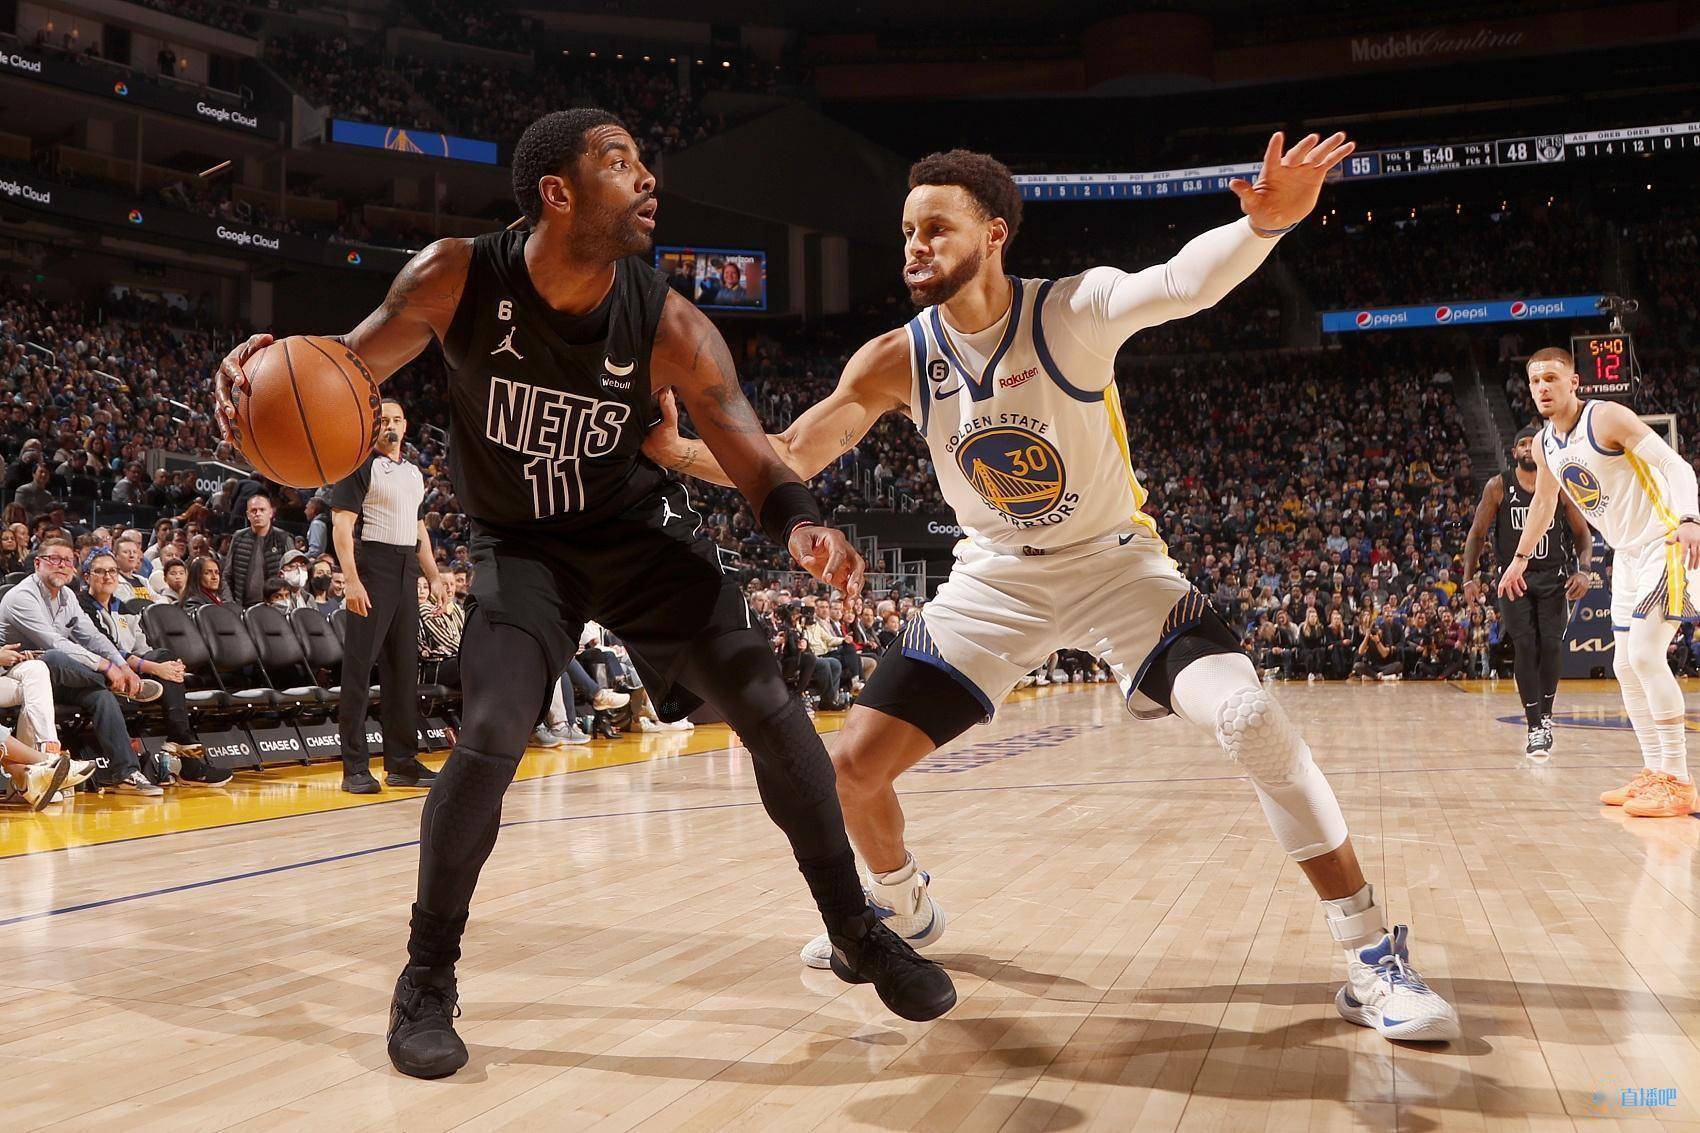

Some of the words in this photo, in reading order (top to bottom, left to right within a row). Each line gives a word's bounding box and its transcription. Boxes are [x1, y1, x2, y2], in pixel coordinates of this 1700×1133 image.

[1351, 36, 1424, 62] Modelo
[10, 54, 41, 72] Cloud
[196, 101, 229, 121] Google
[231, 112, 257, 127] Cloud
[1465, 146, 1480, 154] TOL
[1507, 143, 1527, 161] 48
[1575, 145, 1586, 157] 13
[1606, 142, 1613, 154] 4
[1633, 140, 1645, 152] 12
[1664, 137, 1671, 150] 0
[1693, 135, 1700, 147] 0
[1386, 152, 1401, 161] TOL
[1423, 147, 1453, 164] 5:40
[1465, 158, 1480, 166] FLS
[1484, 155, 1491, 165] 4
[1352, 156, 1370, 175] 55
[1387, 164, 1401, 172] FLS
[22, 185, 50, 203] Cloud
[1084, 185, 1091, 196] 2
[1132, 184, 1142, 195] 12
[1156, 183, 1168, 194] 26
[1183, 180, 1202, 192] 63.6
[216, 226, 251, 244] Google
[252, 235, 279, 250] Cloud
[498, 300, 513, 320] 6
[1453, 307, 1487, 321] pepsi
[1529, 302, 1564, 316] pepsi
[1374, 312, 1407, 325] pepsi
[1590, 339, 1623, 355] 5:40
[932, 363, 946, 379] 6
[1596, 355, 1620, 380] 12
[602, 377, 631, 390] Webull
[1000, 366, 1039, 388] Rakuten
[1592, 383, 1630, 393] TISSOT
[486, 376, 631, 459] NETS
[945, 415, 993, 453] GOLDEN
[1000, 413, 1049, 434] STATE
[1004, 445, 1048, 477] 30
[523, 456, 585, 519] 11
[1580, 472, 1589, 486] 0
[981, 492, 1079, 530] WARRIORS
[927, 521, 962, 538] Goog
[306, 735, 336, 747] CHASE
[427, 729, 446, 739] CHAS
[208, 744, 239, 758] CHASE
[259, 739, 290, 752] CHASE
